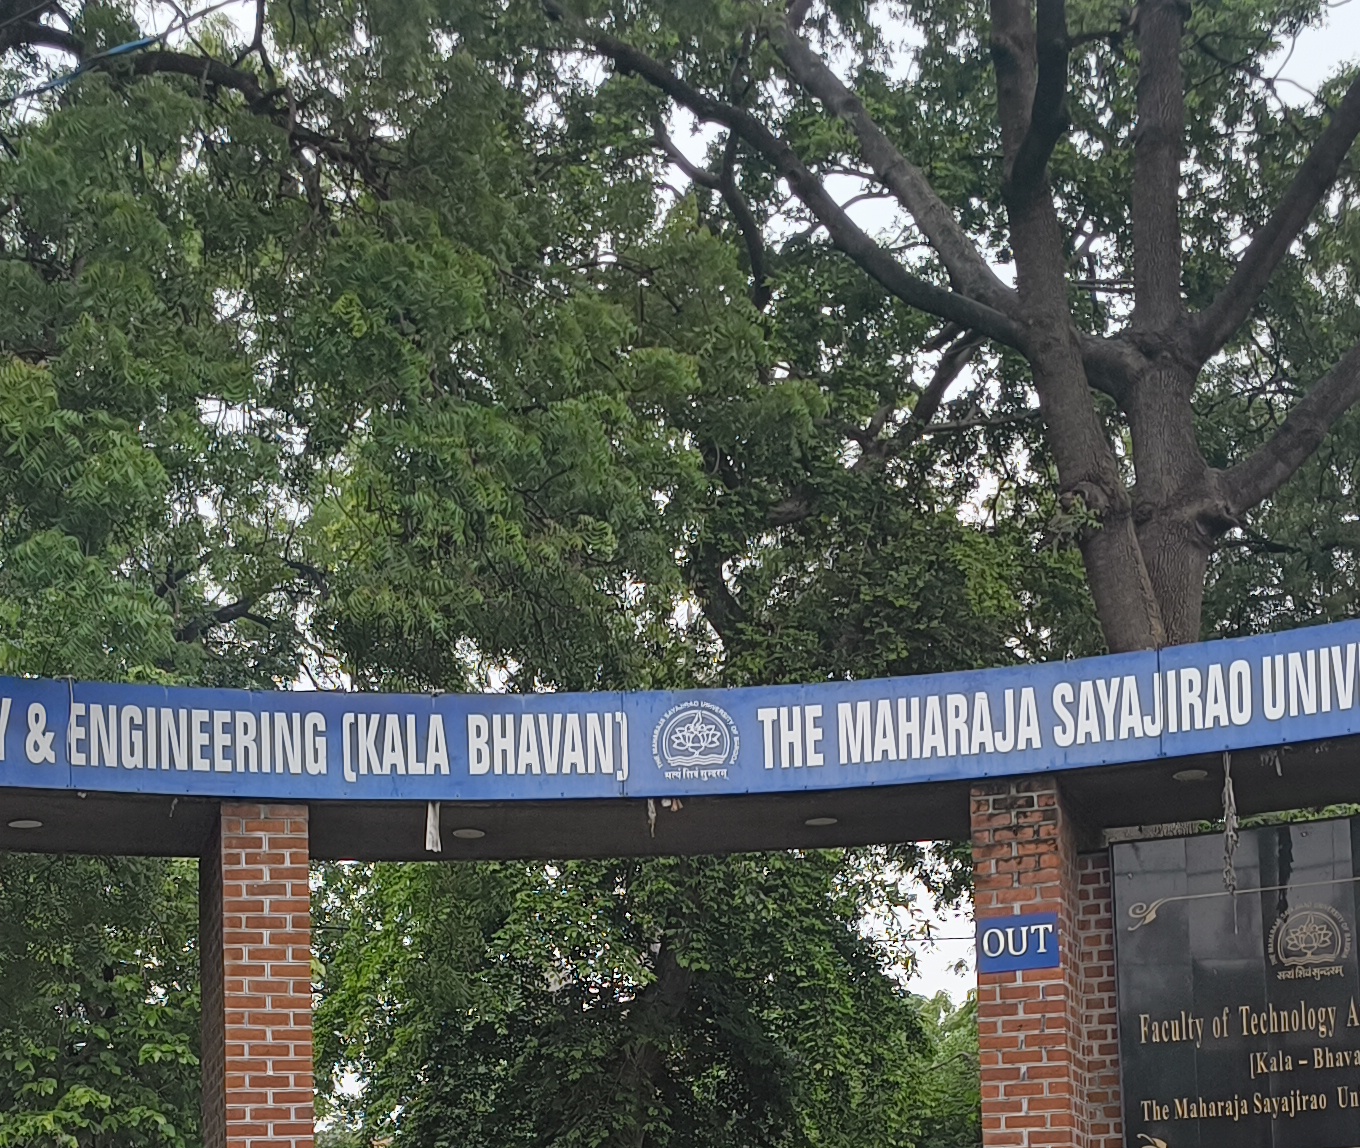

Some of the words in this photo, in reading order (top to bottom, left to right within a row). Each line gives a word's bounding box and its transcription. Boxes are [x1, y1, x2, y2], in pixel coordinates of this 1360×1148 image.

[25, 702, 56, 764] &
[69, 702, 328, 775] ENGINEERING
[757, 705, 825, 769] THE
[838, 687, 1042, 765] MAHARAJA
[1052, 660, 1252, 748] SAYAJIRAO
[982, 924, 1053, 957] OUT
[1139, 1010, 1205, 1048] Faculty
[1212, 1007, 1230, 1038] of
[1239, 1000, 1337, 1038] Technology
[1141, 1099, 1170, 1122] The
[1174, 1094, 1249, 1122] Maharaja
[1253, 1089, 1327, 1119] Sayajirao
